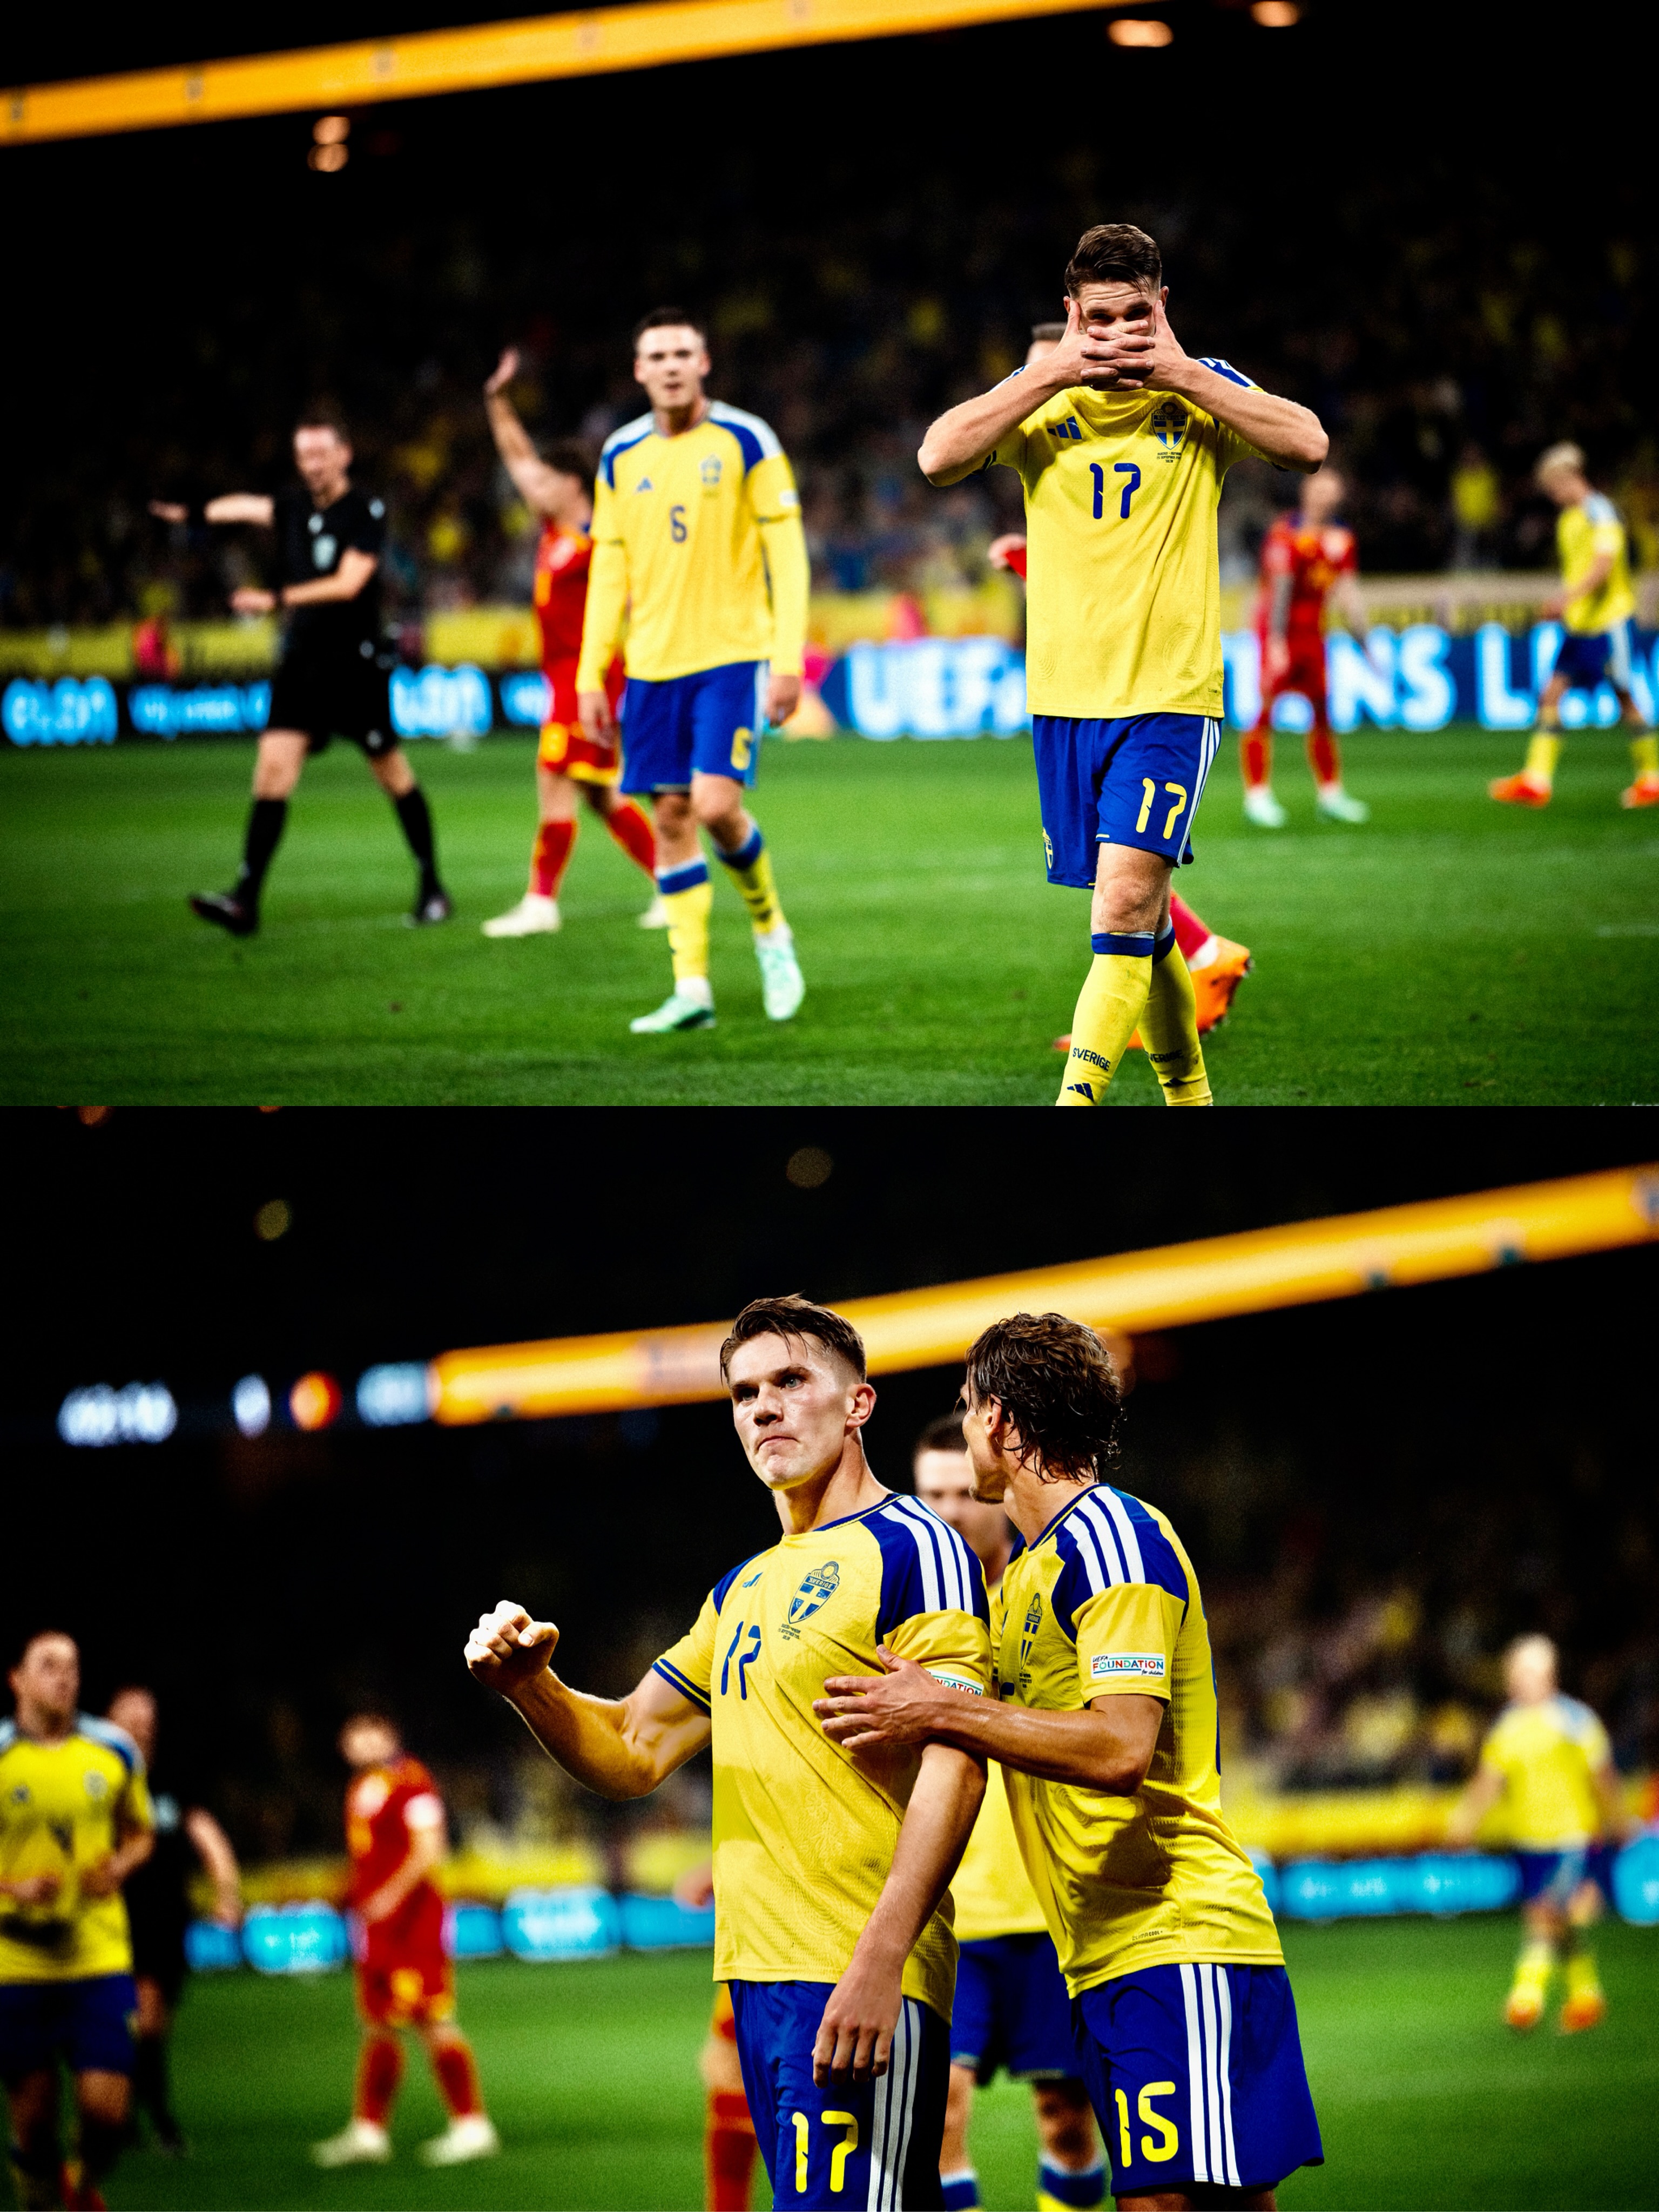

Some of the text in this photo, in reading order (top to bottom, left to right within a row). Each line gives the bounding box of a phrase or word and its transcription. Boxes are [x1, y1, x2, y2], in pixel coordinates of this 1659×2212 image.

[1089, 463, 1141, 520] 17
[669, 505, 687, 543] 6
[1136, 777, 1187, 840] 17
[1073, 1047, 1111, 1072] SVERIGE
[808, 1576, 833, 1589] SVERIGE
[720, 1621, 761, 1701] 17
[1093, 1660, 1164, 1671] FOUNDATION
[792, 2110, 859, 2193] 17
[1115, 2081, 1179, 2168] 15
